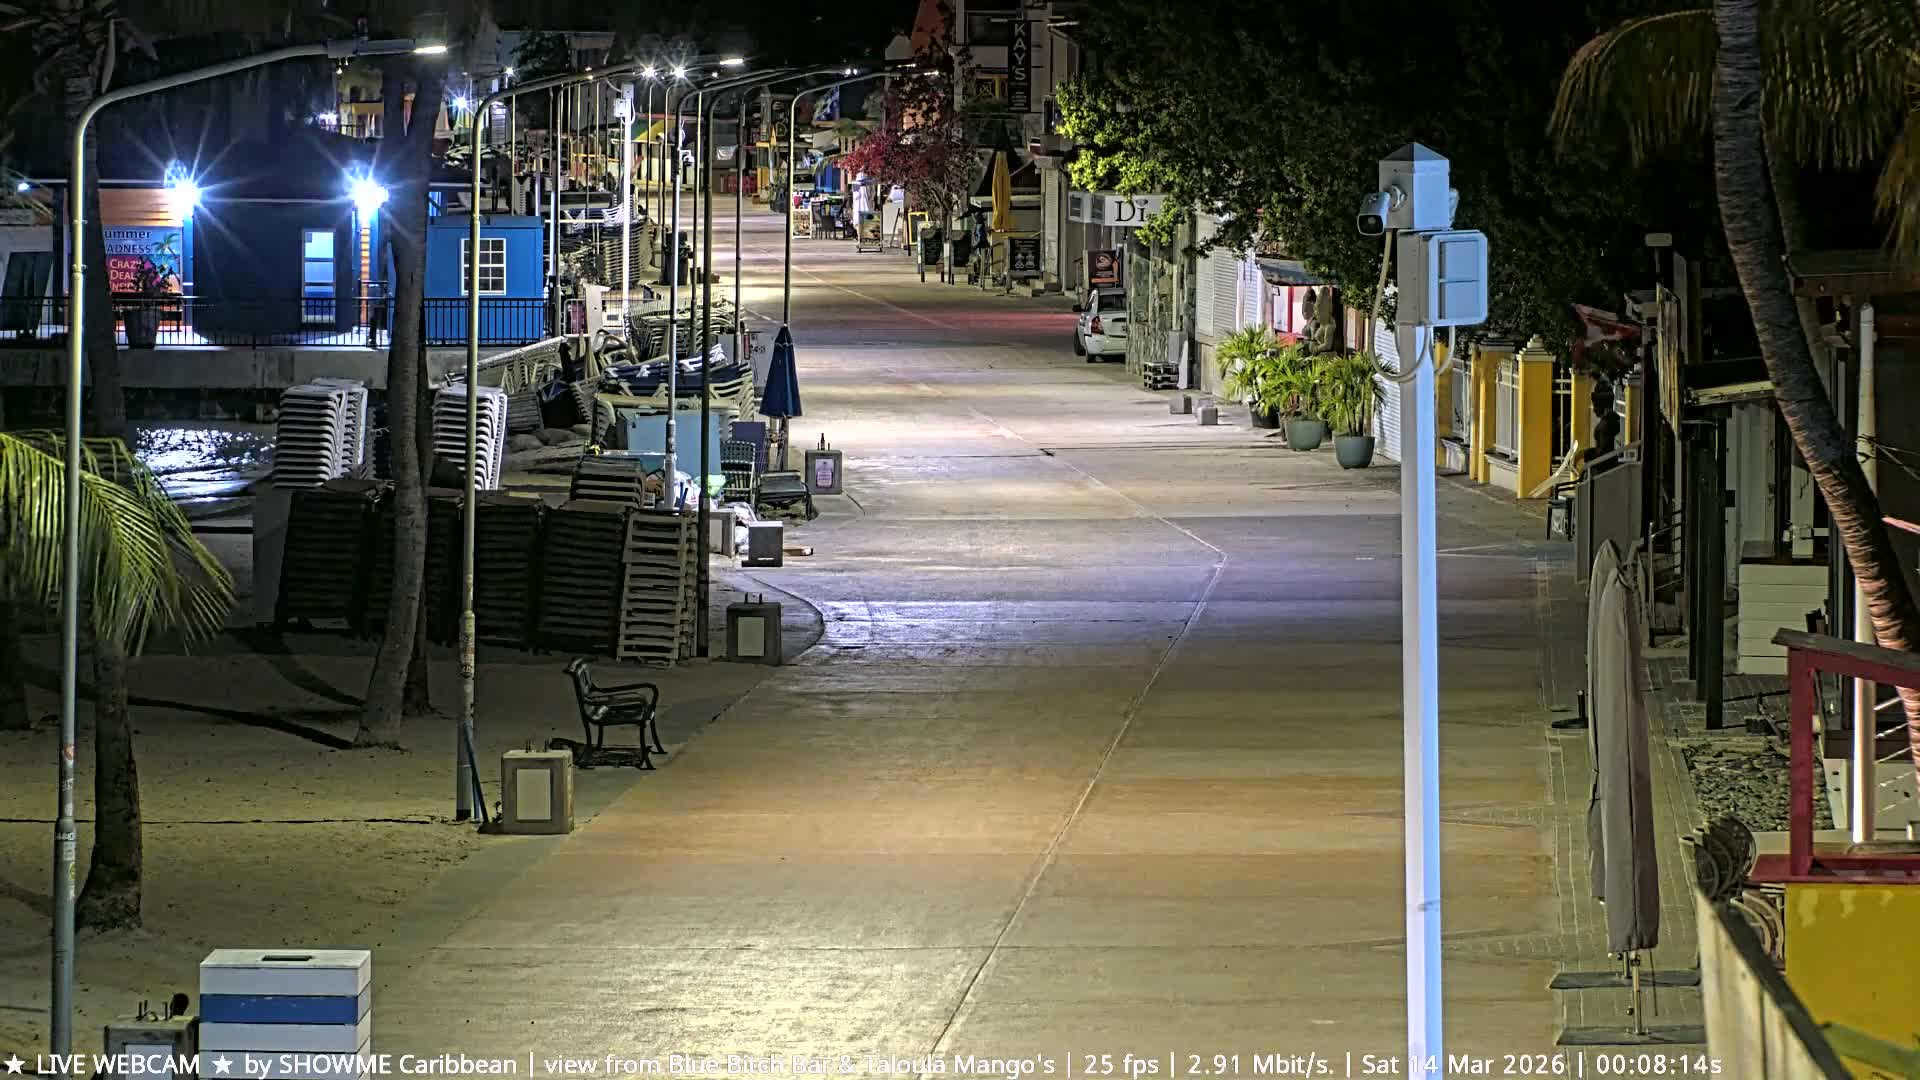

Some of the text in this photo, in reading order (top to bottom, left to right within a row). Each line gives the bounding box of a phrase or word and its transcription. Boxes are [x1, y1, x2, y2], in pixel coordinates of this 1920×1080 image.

[1013, 23, 1027, 80] KAY'S
[1114, 198, 1149, 222] Di
[104, 230, 152, 239] ummer
[107, 244, 152, 253] ADNESS
[110, 270, 137, 280] DEAL
